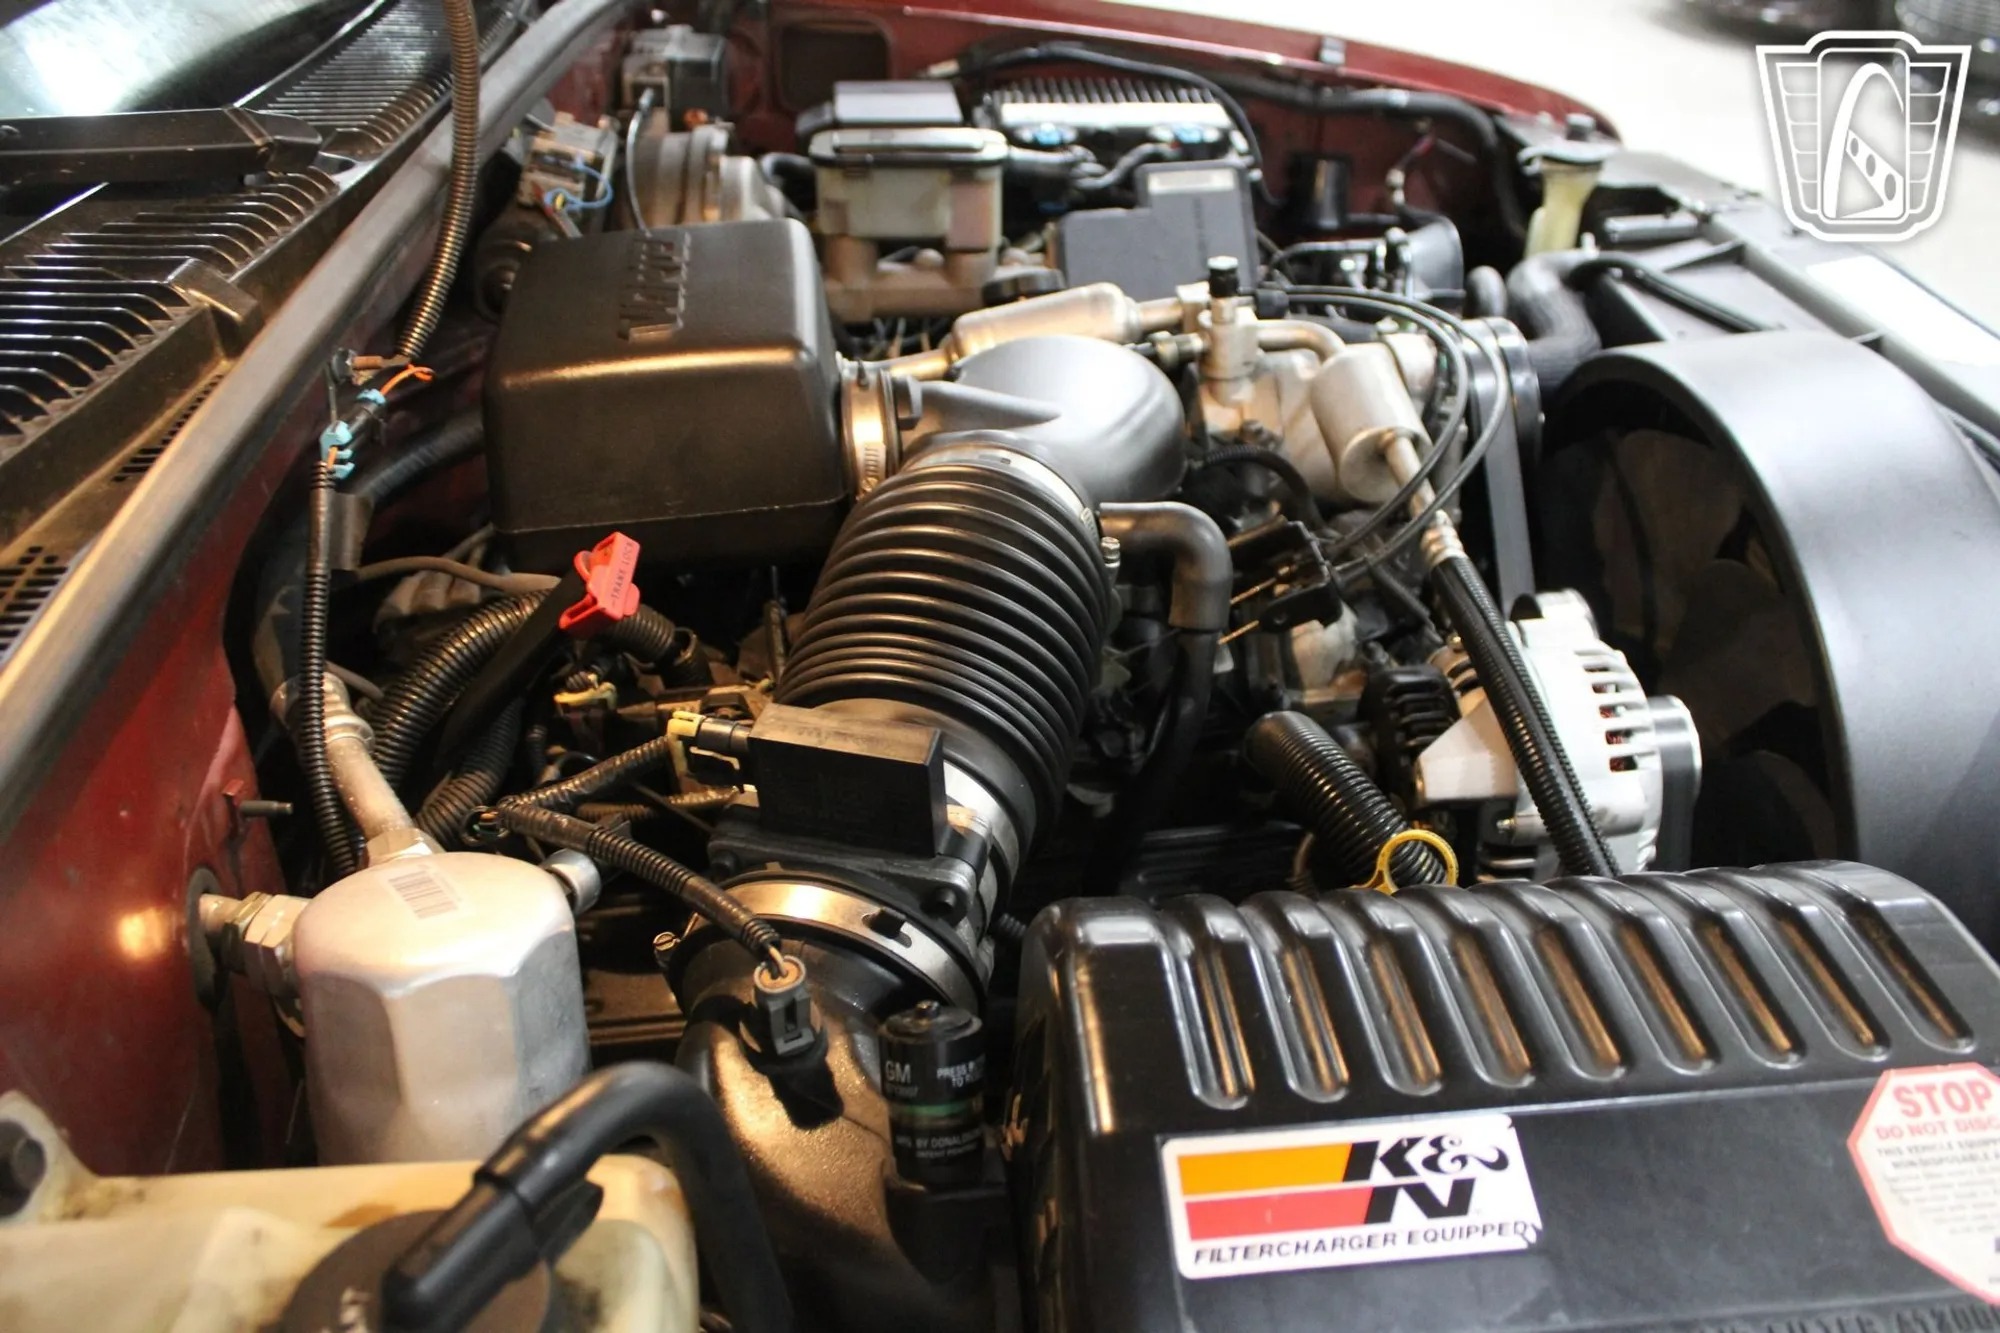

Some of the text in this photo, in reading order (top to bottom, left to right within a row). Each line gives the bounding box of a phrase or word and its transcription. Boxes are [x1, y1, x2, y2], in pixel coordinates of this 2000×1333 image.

[885, 1060, 911, 1083] GM
[1892, 1078, 1993, 1118] STOP
[1876, 1124, 1904, 1140] DO
[1907, 1120, 1949, 1137] NOT
[1194, 1220, 1528, 1265] FILTERCHARGER EQUIPPED
